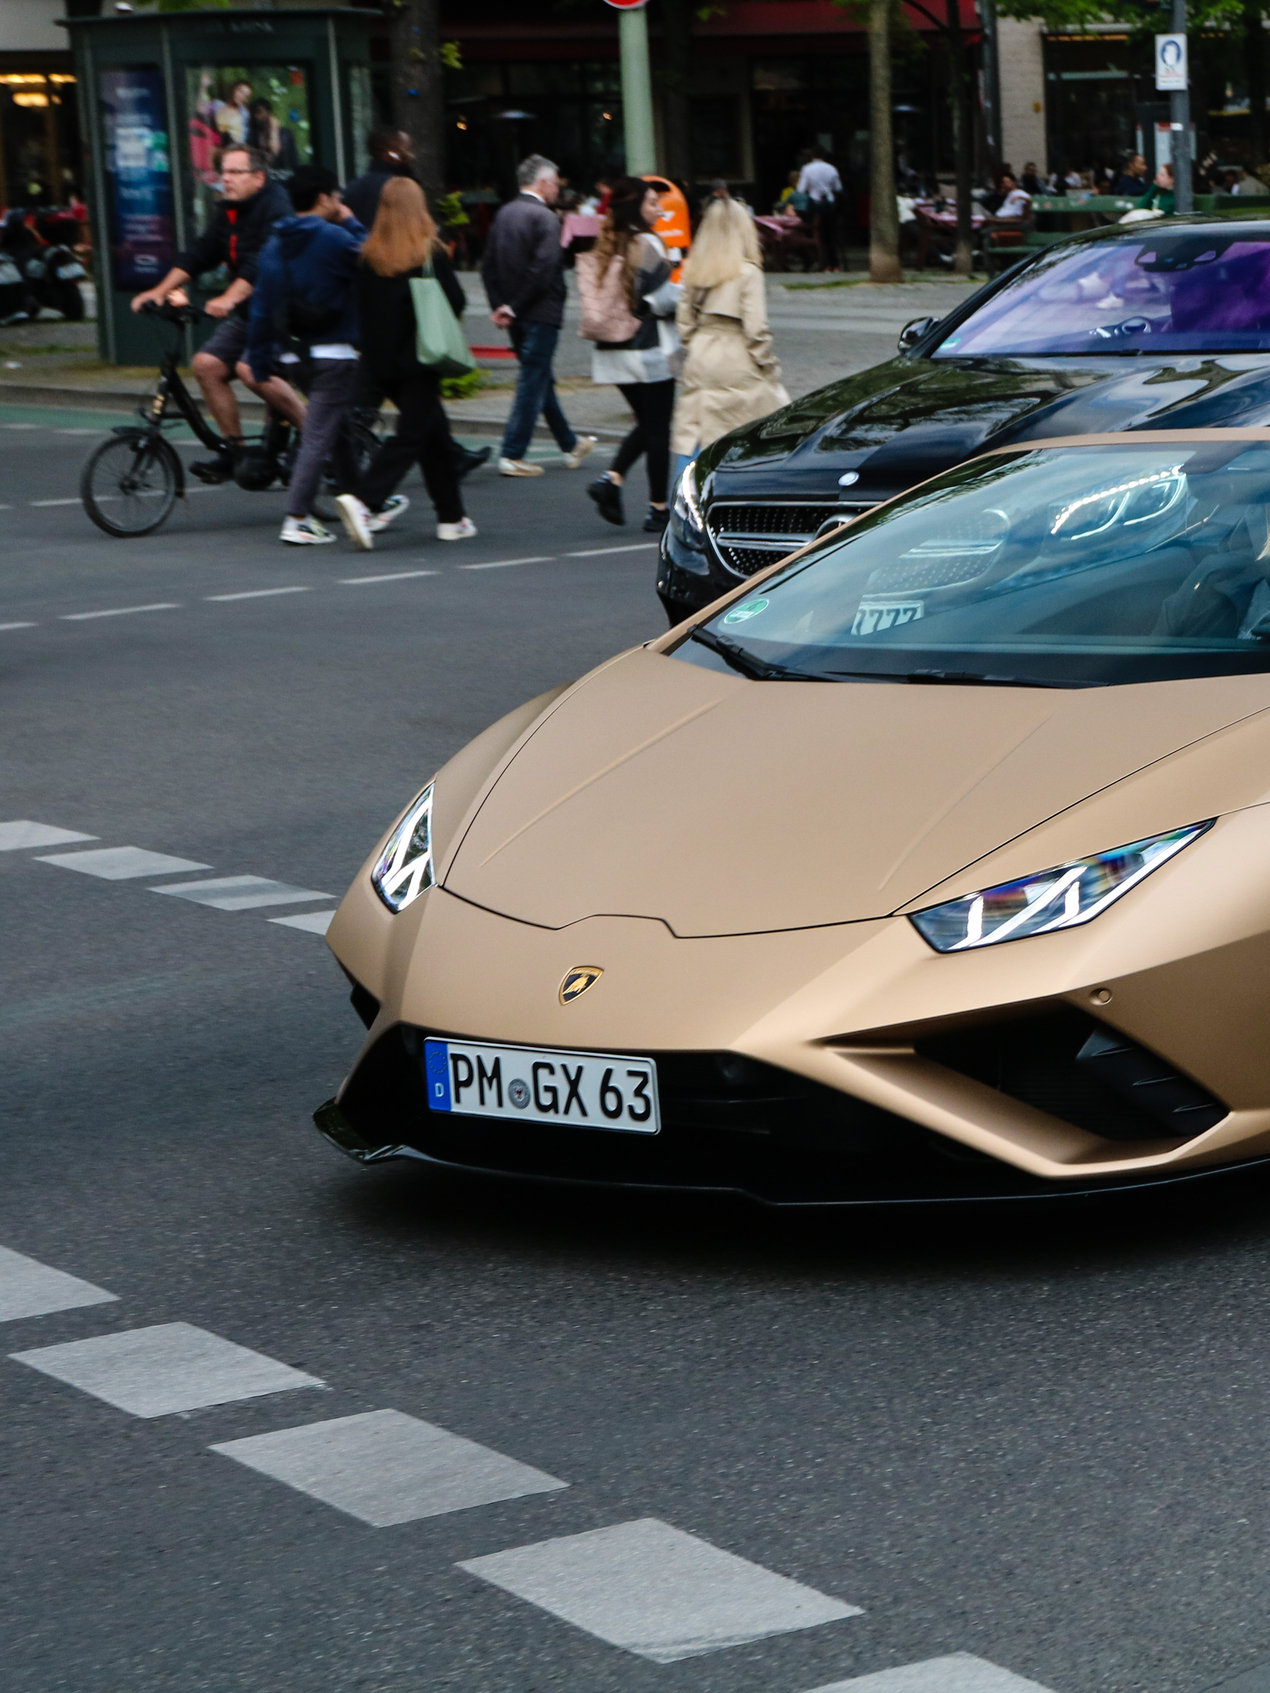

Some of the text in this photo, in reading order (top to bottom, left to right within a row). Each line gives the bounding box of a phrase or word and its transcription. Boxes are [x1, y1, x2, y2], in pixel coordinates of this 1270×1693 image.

[435, 1083, 444, 1097] D
[450, 1052, 651, 1121] PM GX 63
